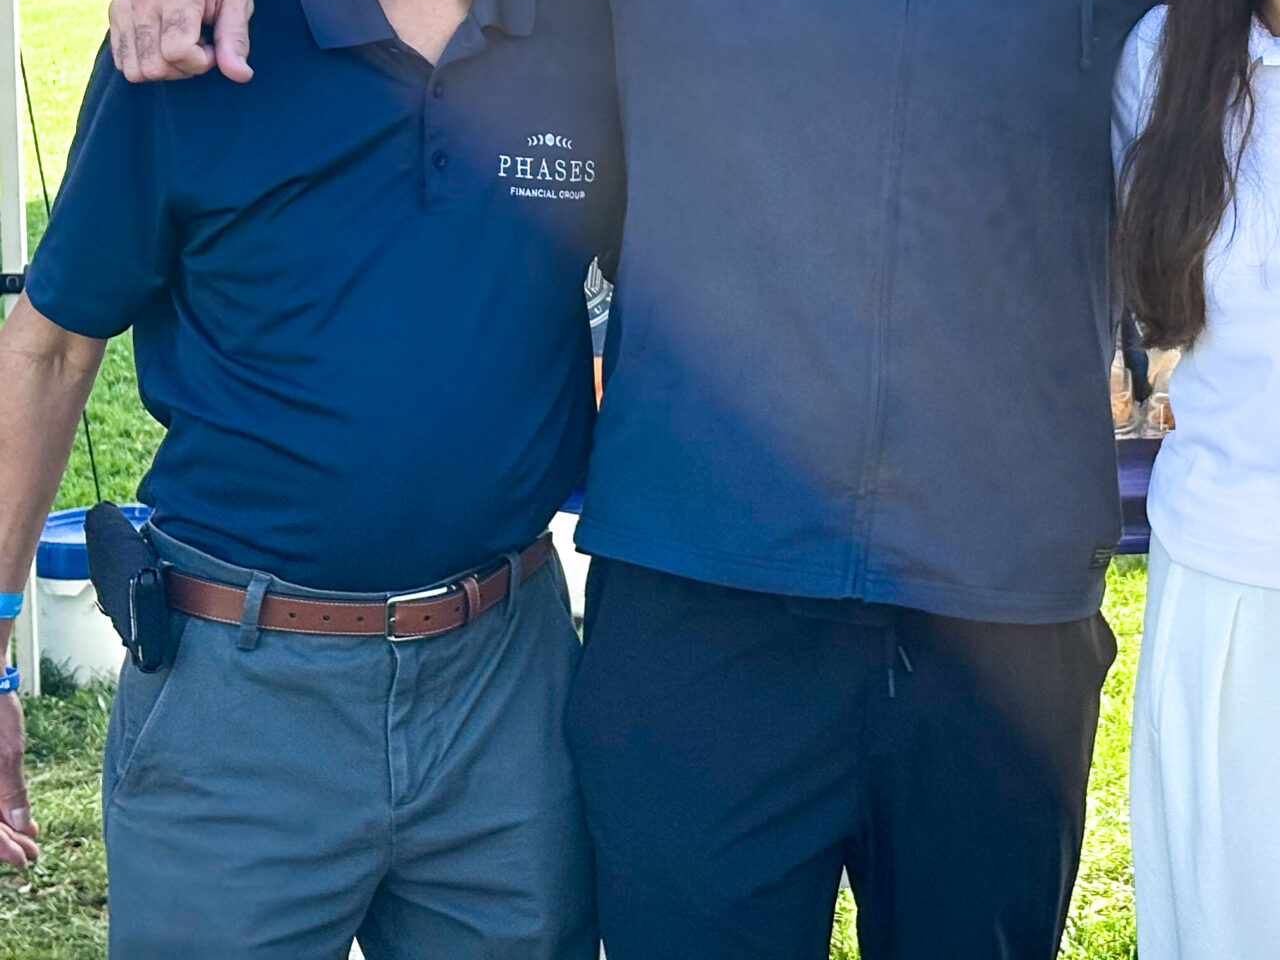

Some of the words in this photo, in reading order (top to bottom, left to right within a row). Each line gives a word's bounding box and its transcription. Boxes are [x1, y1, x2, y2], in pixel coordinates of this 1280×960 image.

[498, 154, 596, 183] PHASES
[510, 186, 557, 199] FINANCIAL
[558, 190, 586, 200] GROUP
